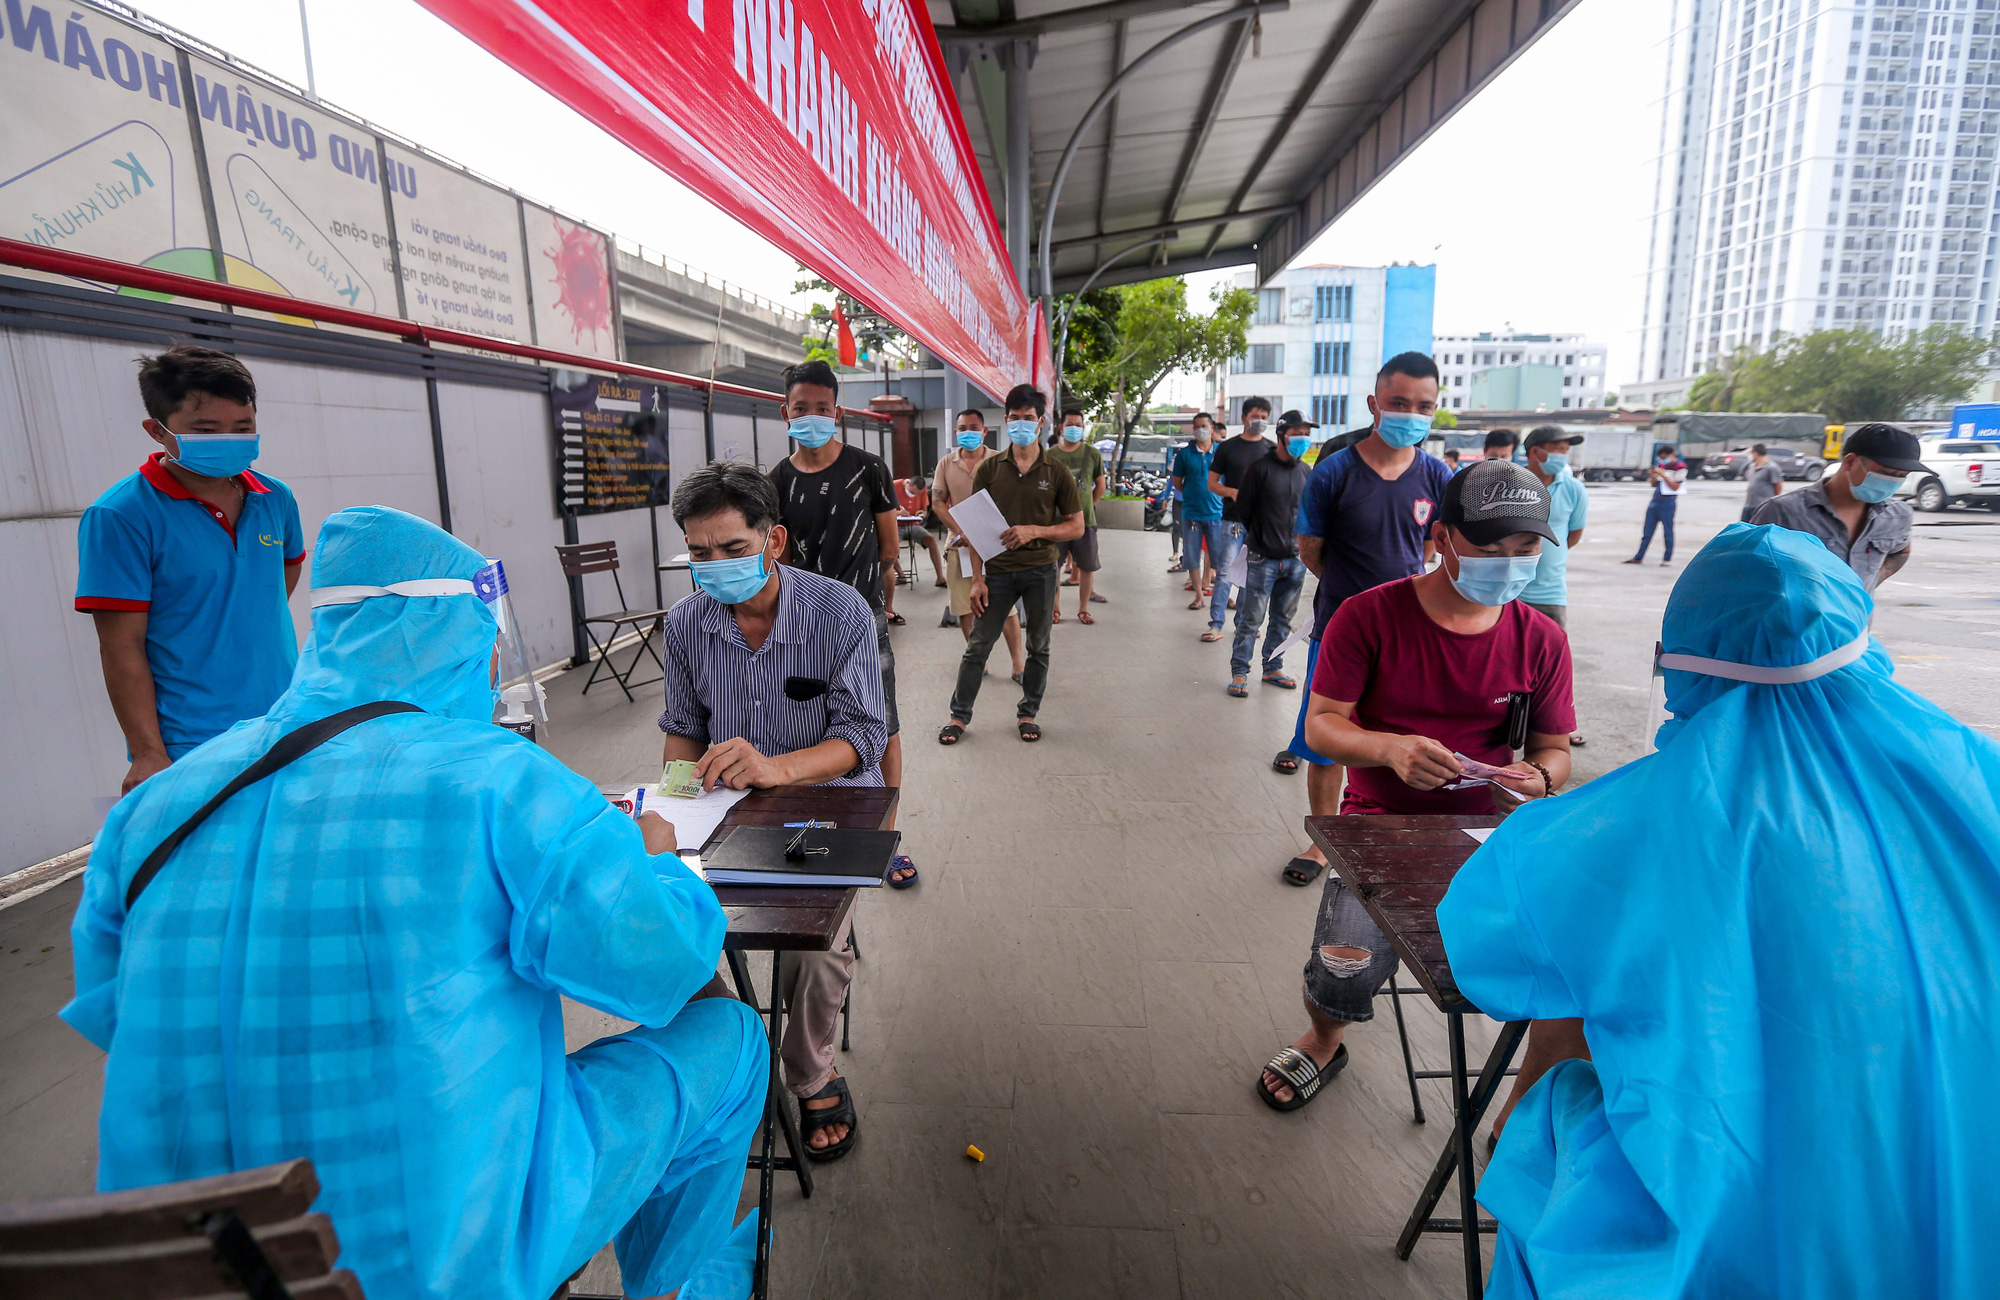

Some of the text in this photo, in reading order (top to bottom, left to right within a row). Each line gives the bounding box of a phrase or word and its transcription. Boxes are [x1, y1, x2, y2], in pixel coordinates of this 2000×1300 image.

[732, 0, 859, 208] NHANH
[865, 120, 922, 279] KHÁNG
[597, 380, 610, 398] LỐI
[610, 385, 622, 400] RA
[626, 388, 642, 402] EXIT
[1481, 480, 1542, 504] Puma
